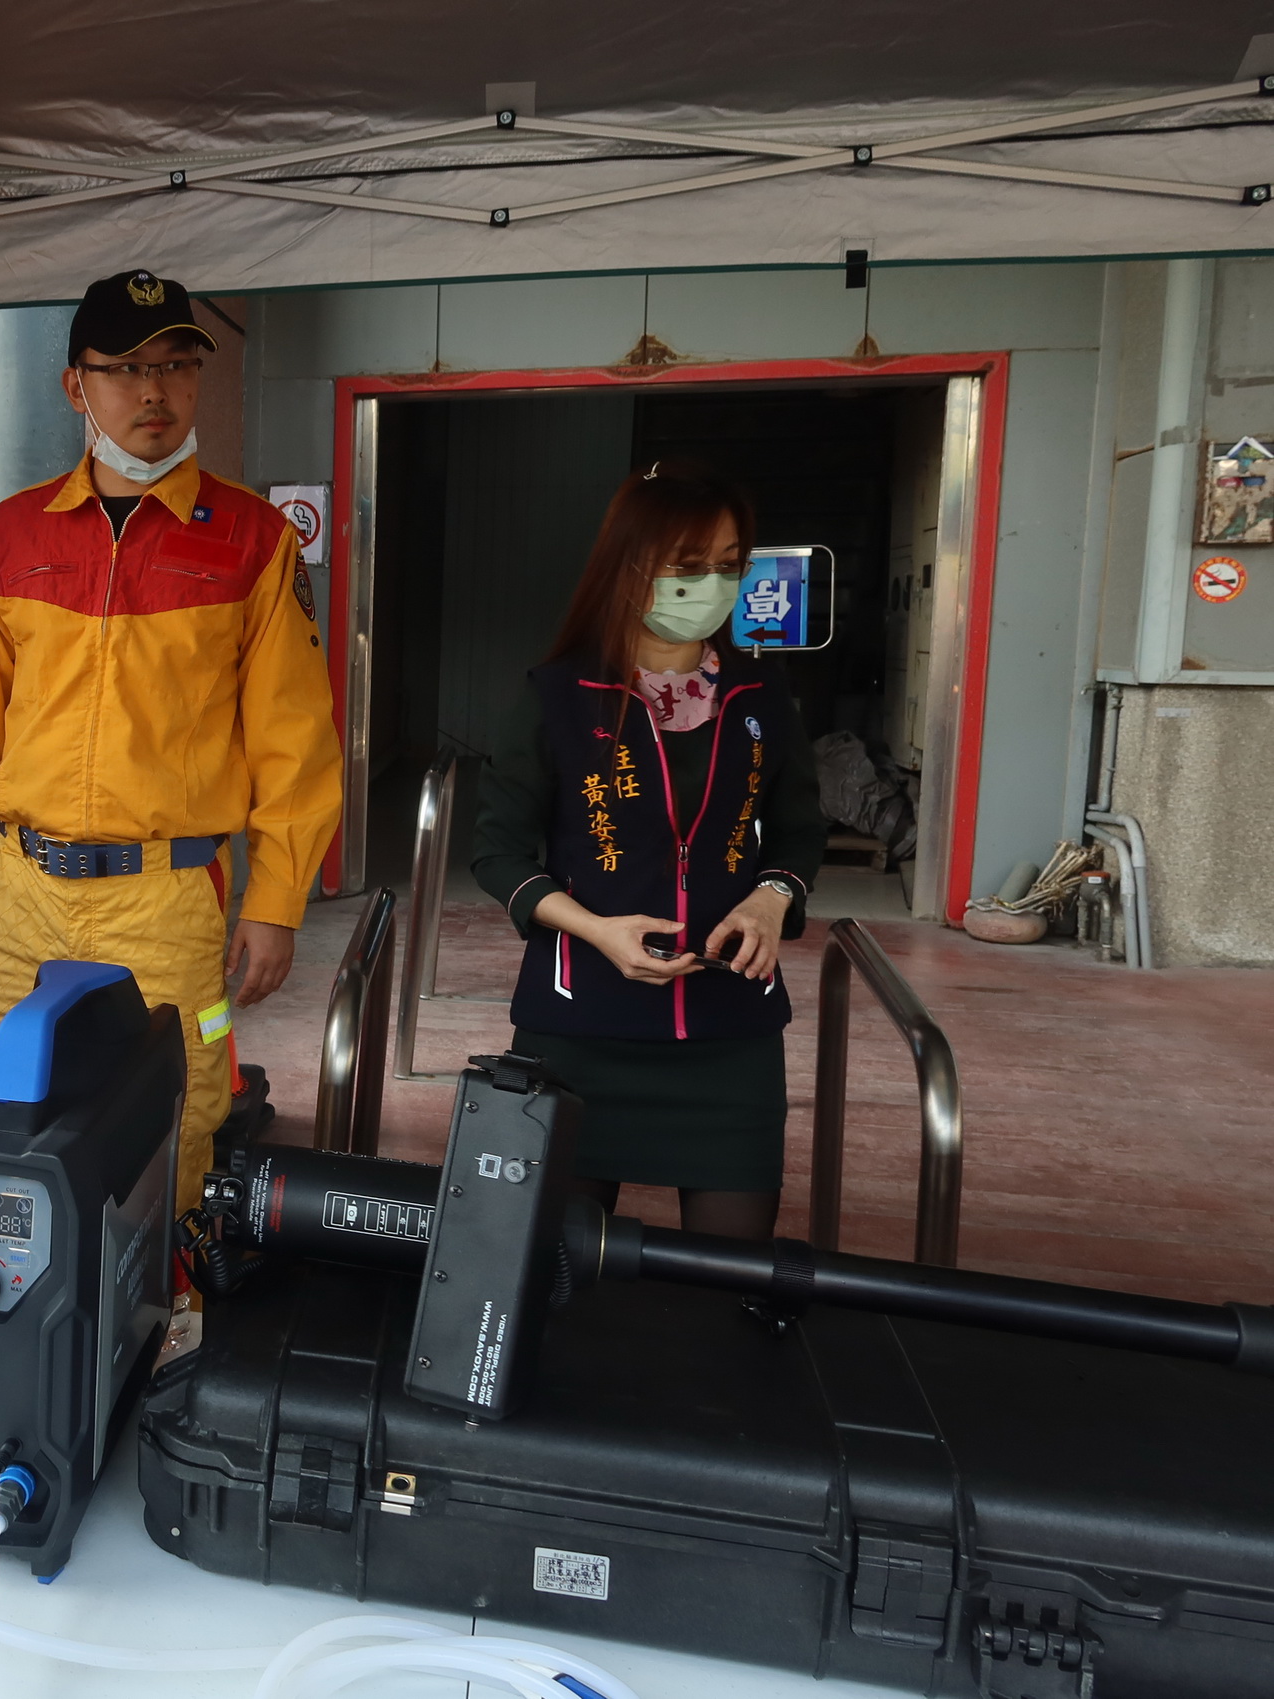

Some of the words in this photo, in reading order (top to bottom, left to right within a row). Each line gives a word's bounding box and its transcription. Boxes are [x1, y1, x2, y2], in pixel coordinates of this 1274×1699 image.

[614, 744, 640, 799] 主任
[496, 1313, 507, 1342] VIDEO
[467, 1301, 493, 1403] WWW.SAVOX.COM
[488, 1344, 502, 1383] DISPLAY
[485, 1385, 495, 1407] UNIT
